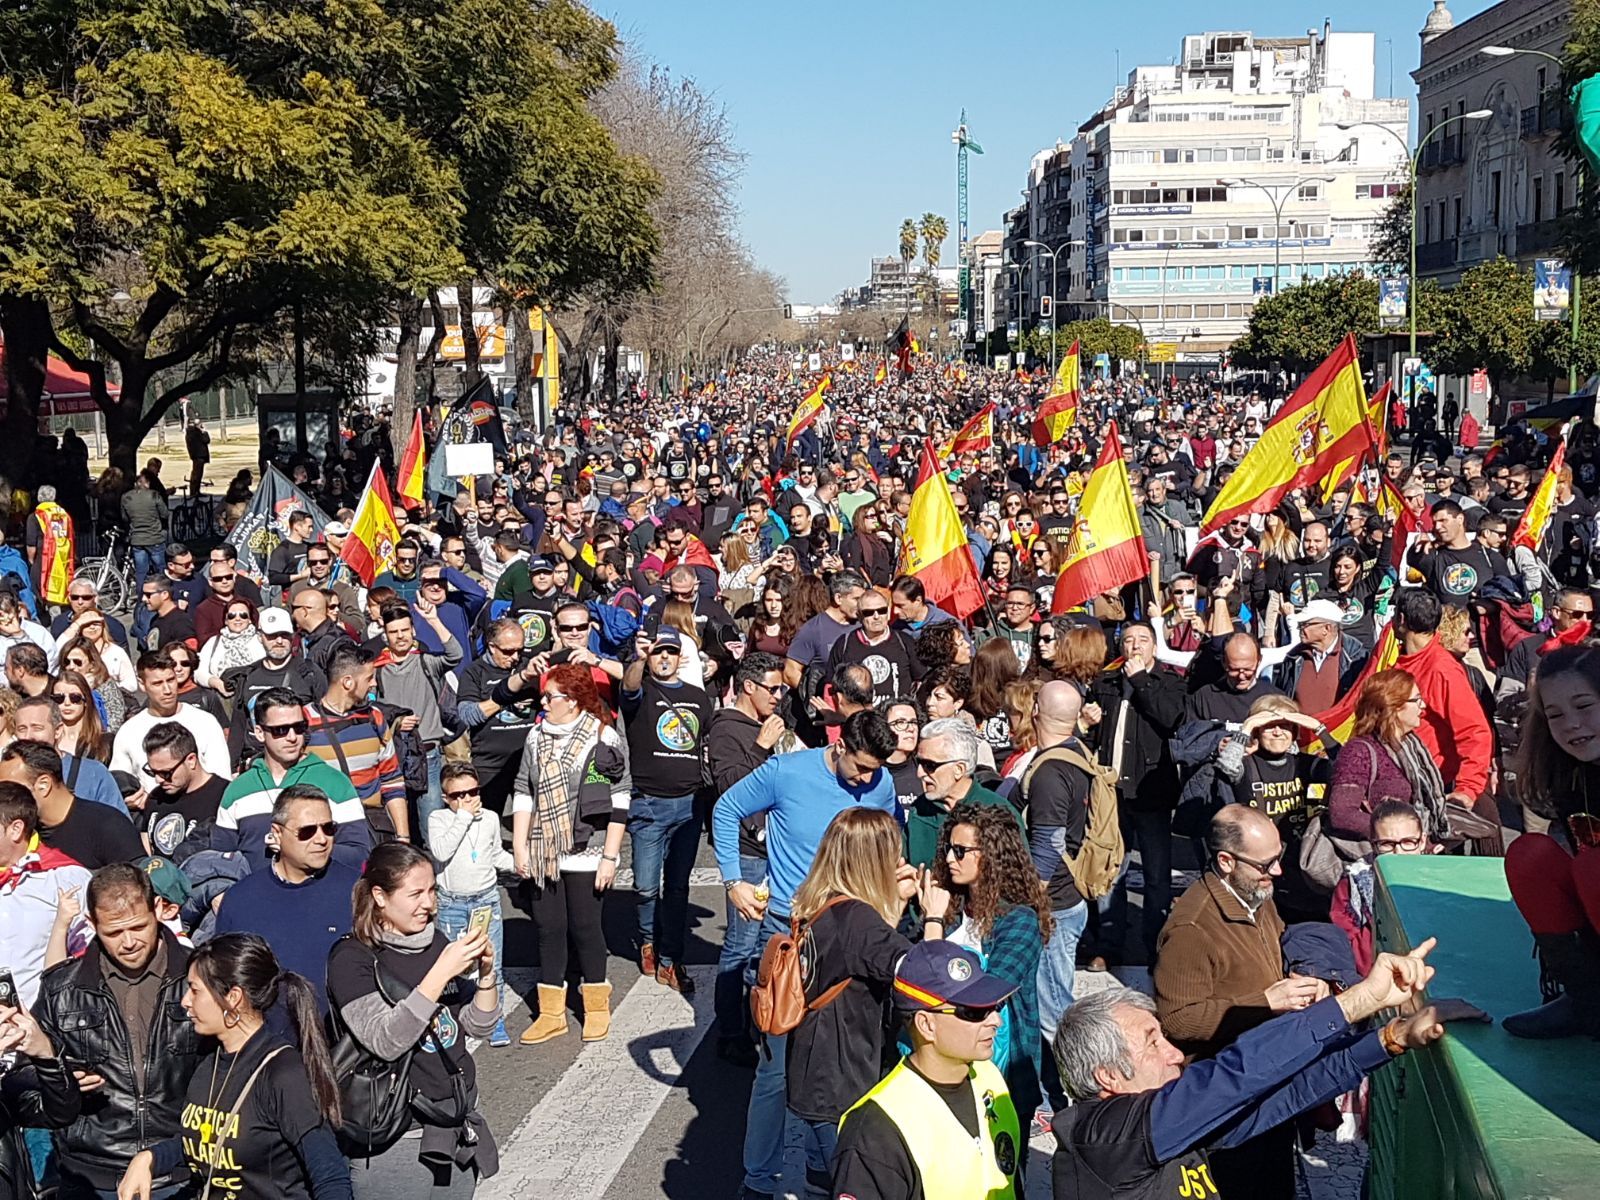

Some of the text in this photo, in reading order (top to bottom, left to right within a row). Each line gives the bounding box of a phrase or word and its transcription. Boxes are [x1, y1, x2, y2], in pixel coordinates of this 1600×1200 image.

[1086, 179, 1095, 280] HOTEL ALCAZAR
[211, 1176, 243, 1191] GC
